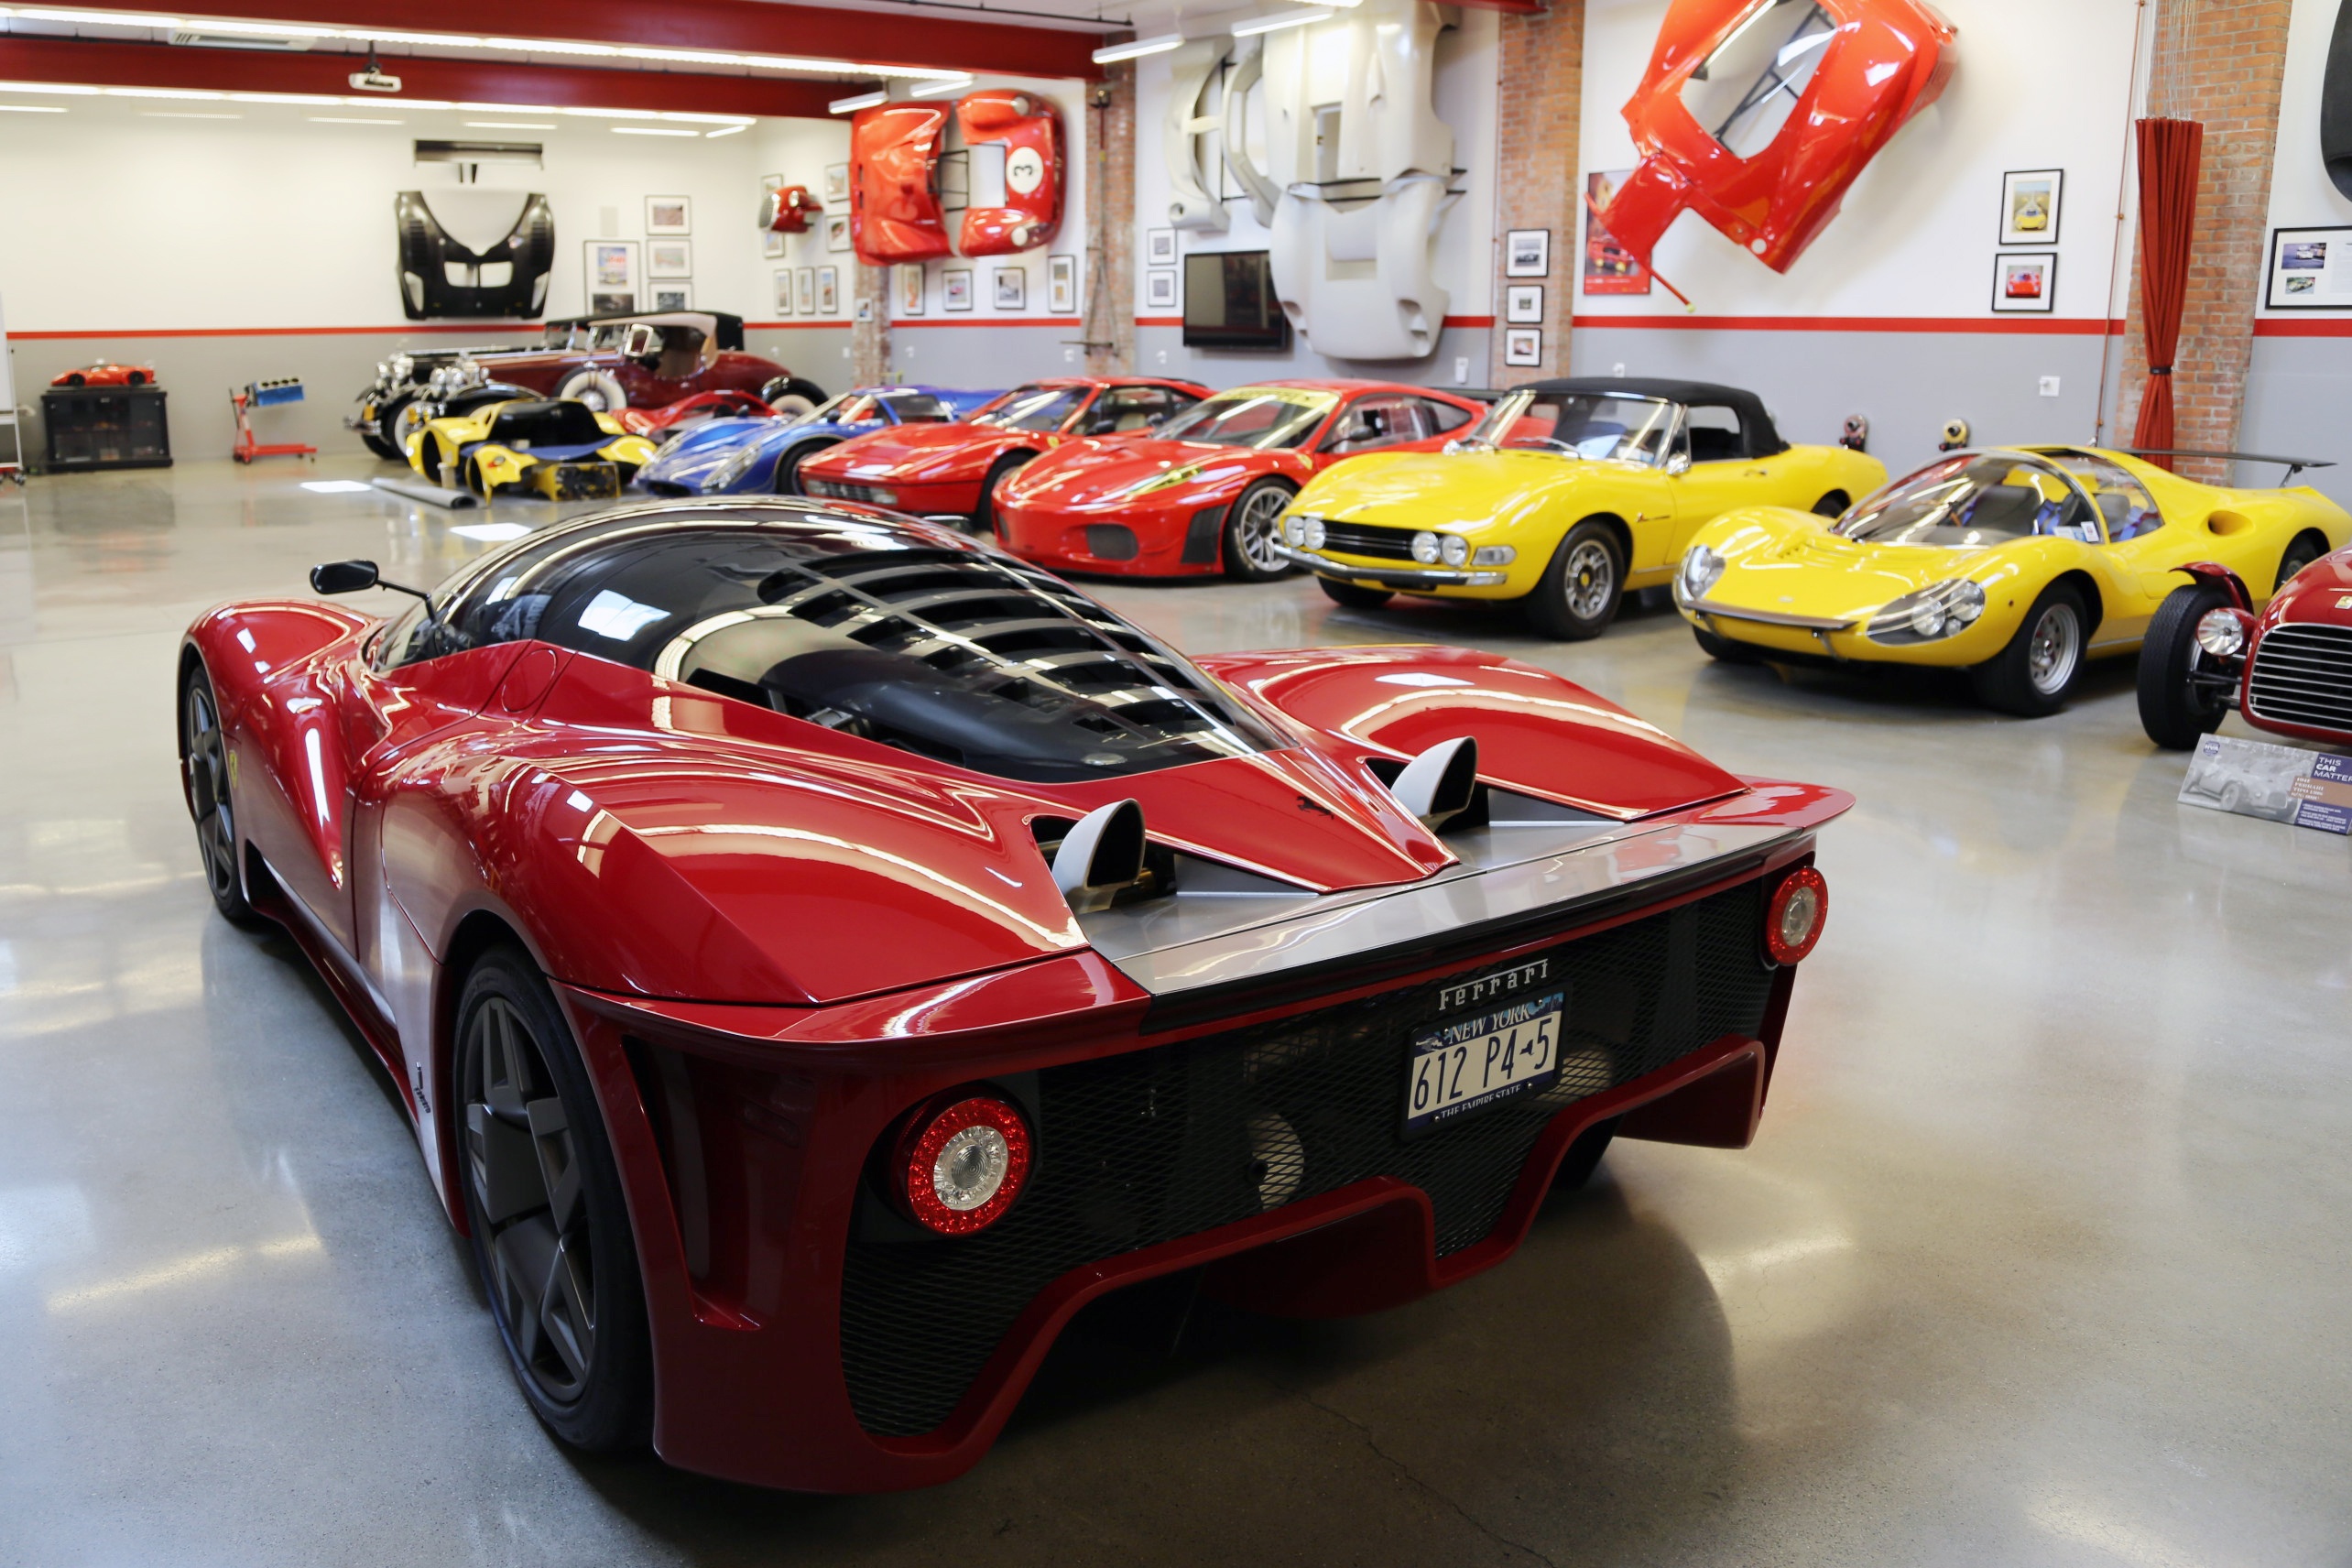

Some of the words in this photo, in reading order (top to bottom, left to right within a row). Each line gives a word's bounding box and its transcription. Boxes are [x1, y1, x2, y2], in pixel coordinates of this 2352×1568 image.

[1014, 165, 1032, 176] 3
[2315, 763, 2336, 772] CAR
[2319, 757, 2342, 767] THIS
[1439, 958, 1548, 1011] Ferrari
[1449, 1018, 1486, 1044] NEW
[1491, 1003, 1530, 1031] YORK
[1413, 1046, 1467, 1111] 612
[1441, 1105, 1460, 1118] THE
[1462, 1094, 1494, 1112] EMPIRE
[1496, 1083, 1521, 1099] STATE
